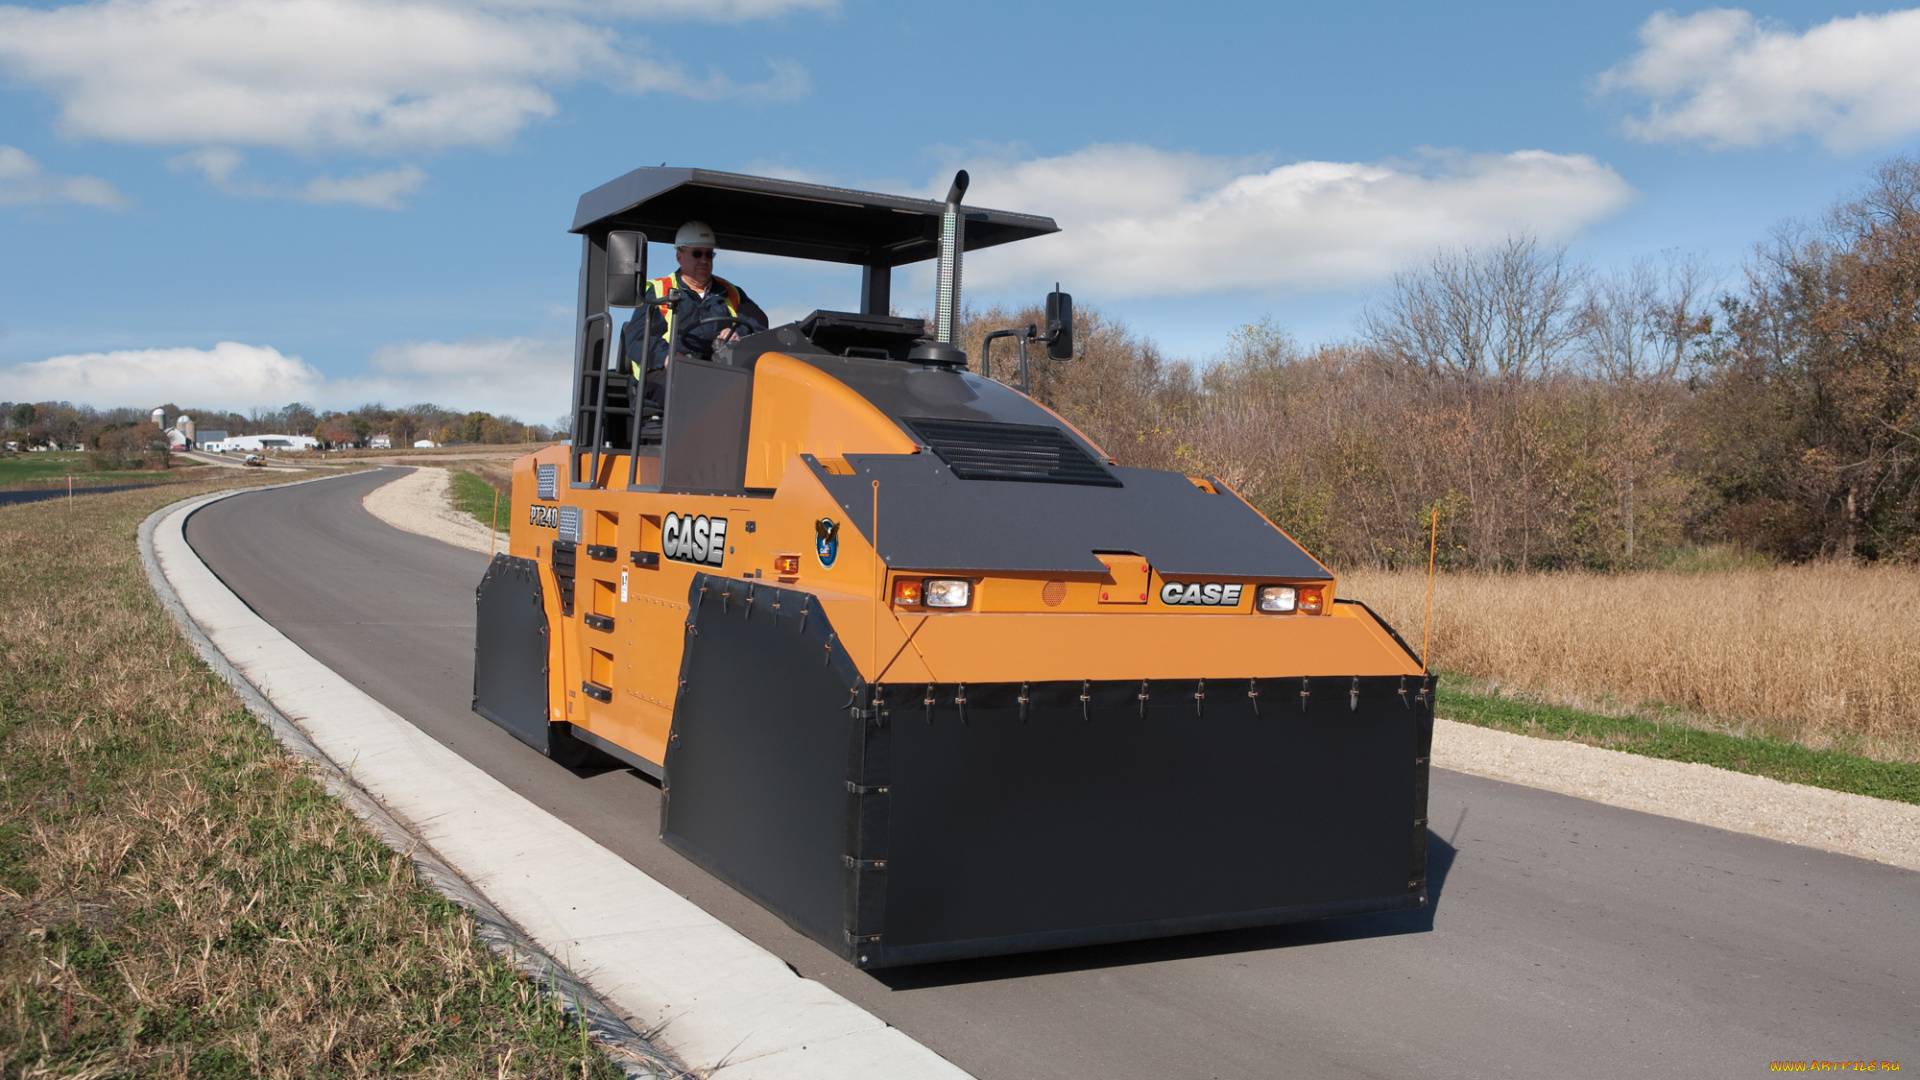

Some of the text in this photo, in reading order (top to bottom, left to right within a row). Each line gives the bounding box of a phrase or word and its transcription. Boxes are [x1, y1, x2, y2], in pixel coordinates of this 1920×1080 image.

[530, 504, 558, 529] PT240
[662, 512, 727, 567] CASE
[1160, 581, 1243, 606] CASE
